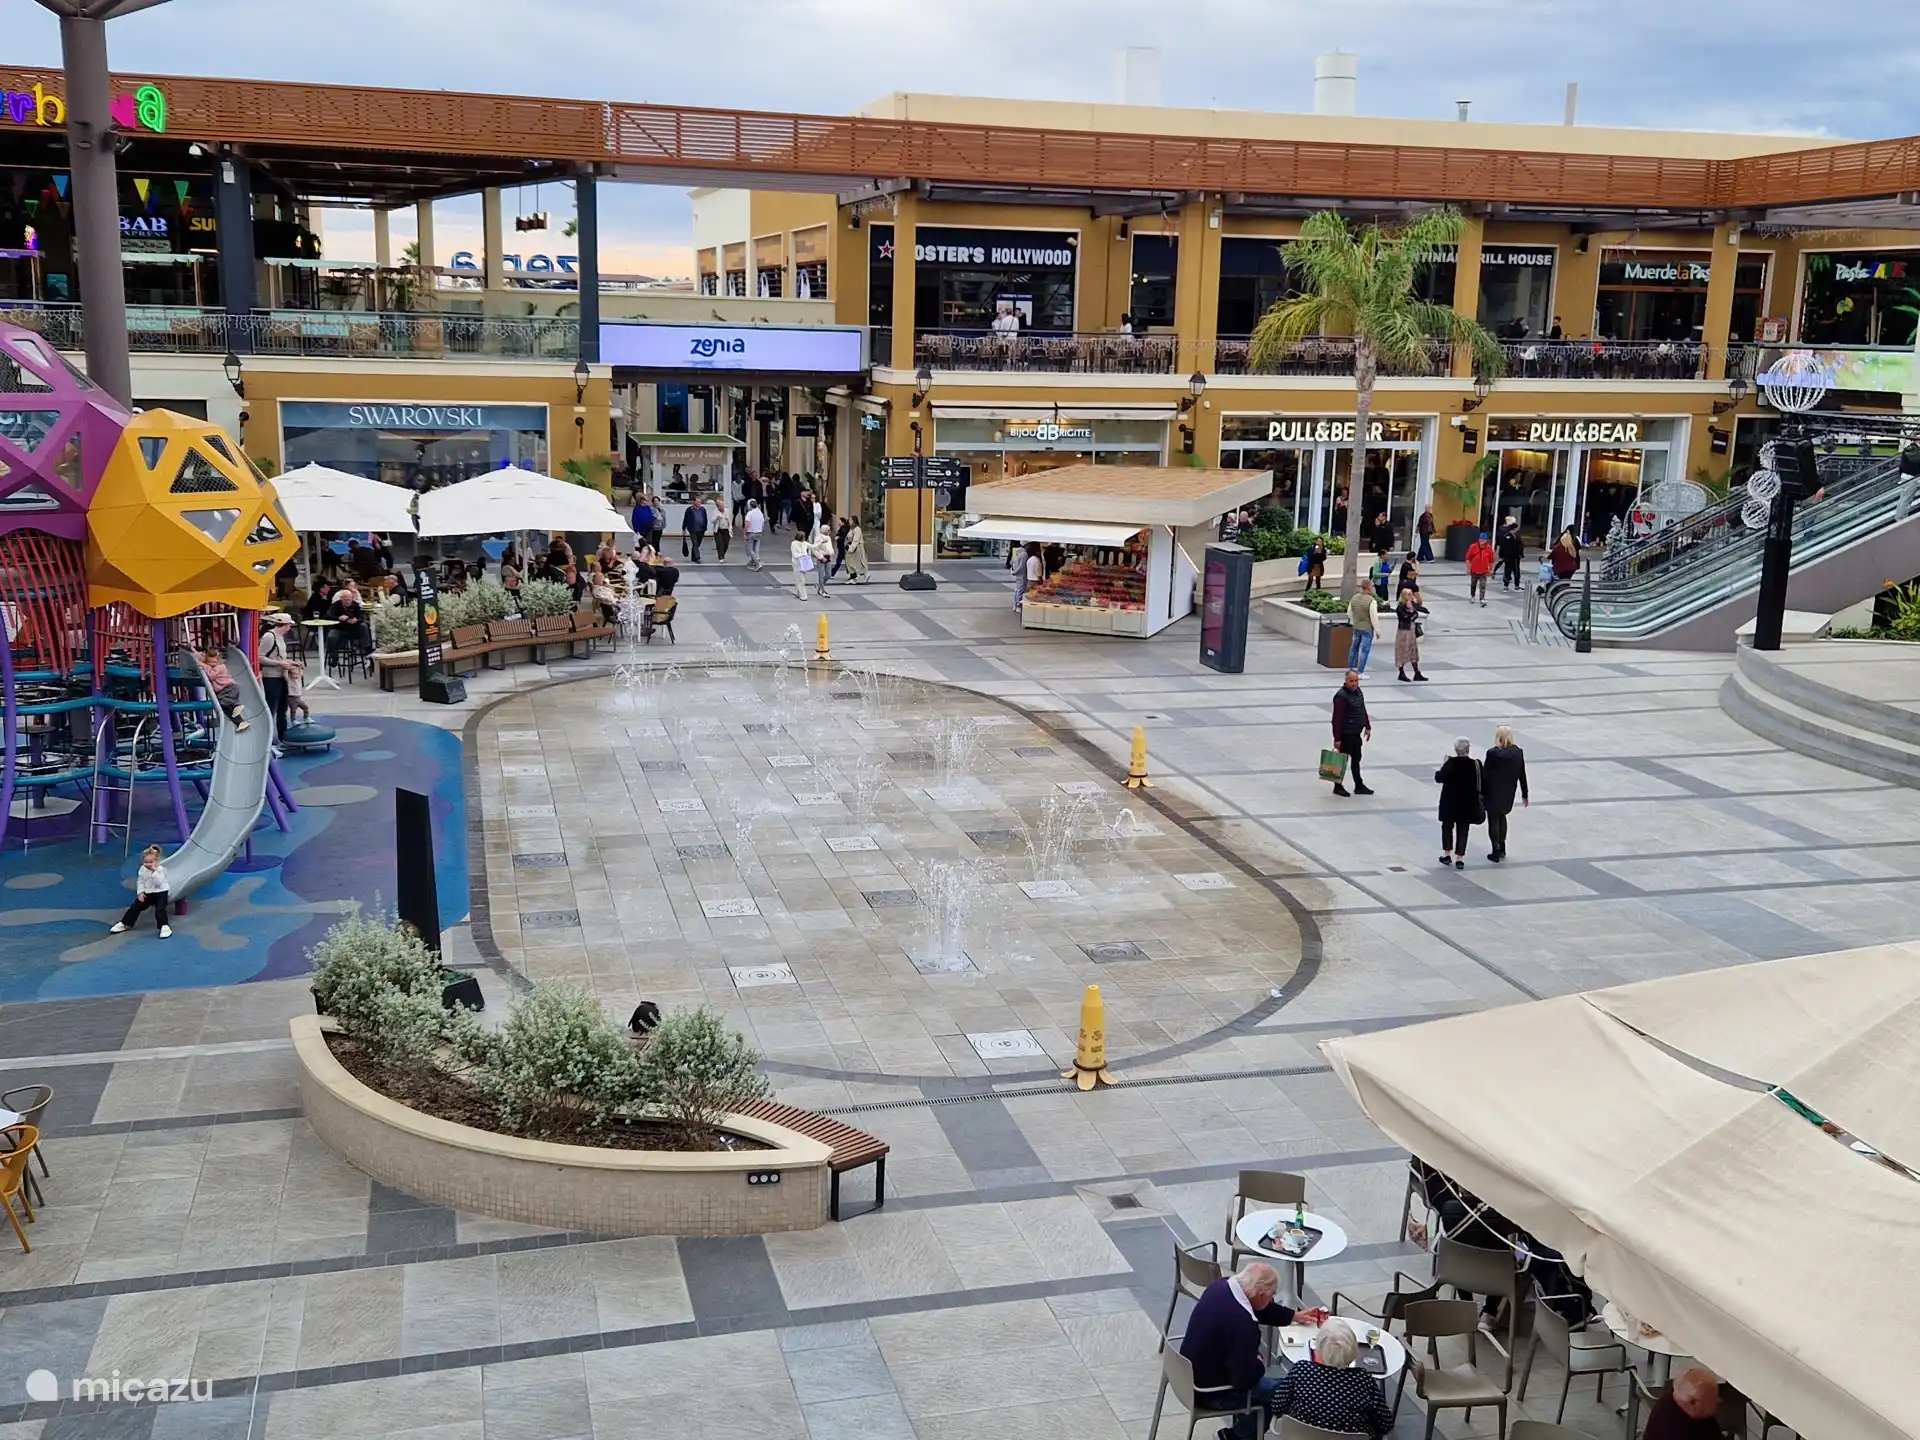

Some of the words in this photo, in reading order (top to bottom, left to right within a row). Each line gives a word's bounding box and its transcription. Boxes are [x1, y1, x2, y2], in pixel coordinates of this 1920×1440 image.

[119, 216, 168, 231] BAB
[189, 217, 217, 231] SU
[915, 244, 985, 264] OSTER'S
[991, 247, 1072, 266] HOLLYWOOD
[1480, 253, 1505, 264] RILL
[1508, 253, 1553, 266] HOUSE
[690, 338, 745, 357] zenia
[349, 405, 483, 426] SWAROVSKI
[1268, 421, 1384, 442] PULL&BER
[1529, 422, 1638, 442] PULL&BEAR
